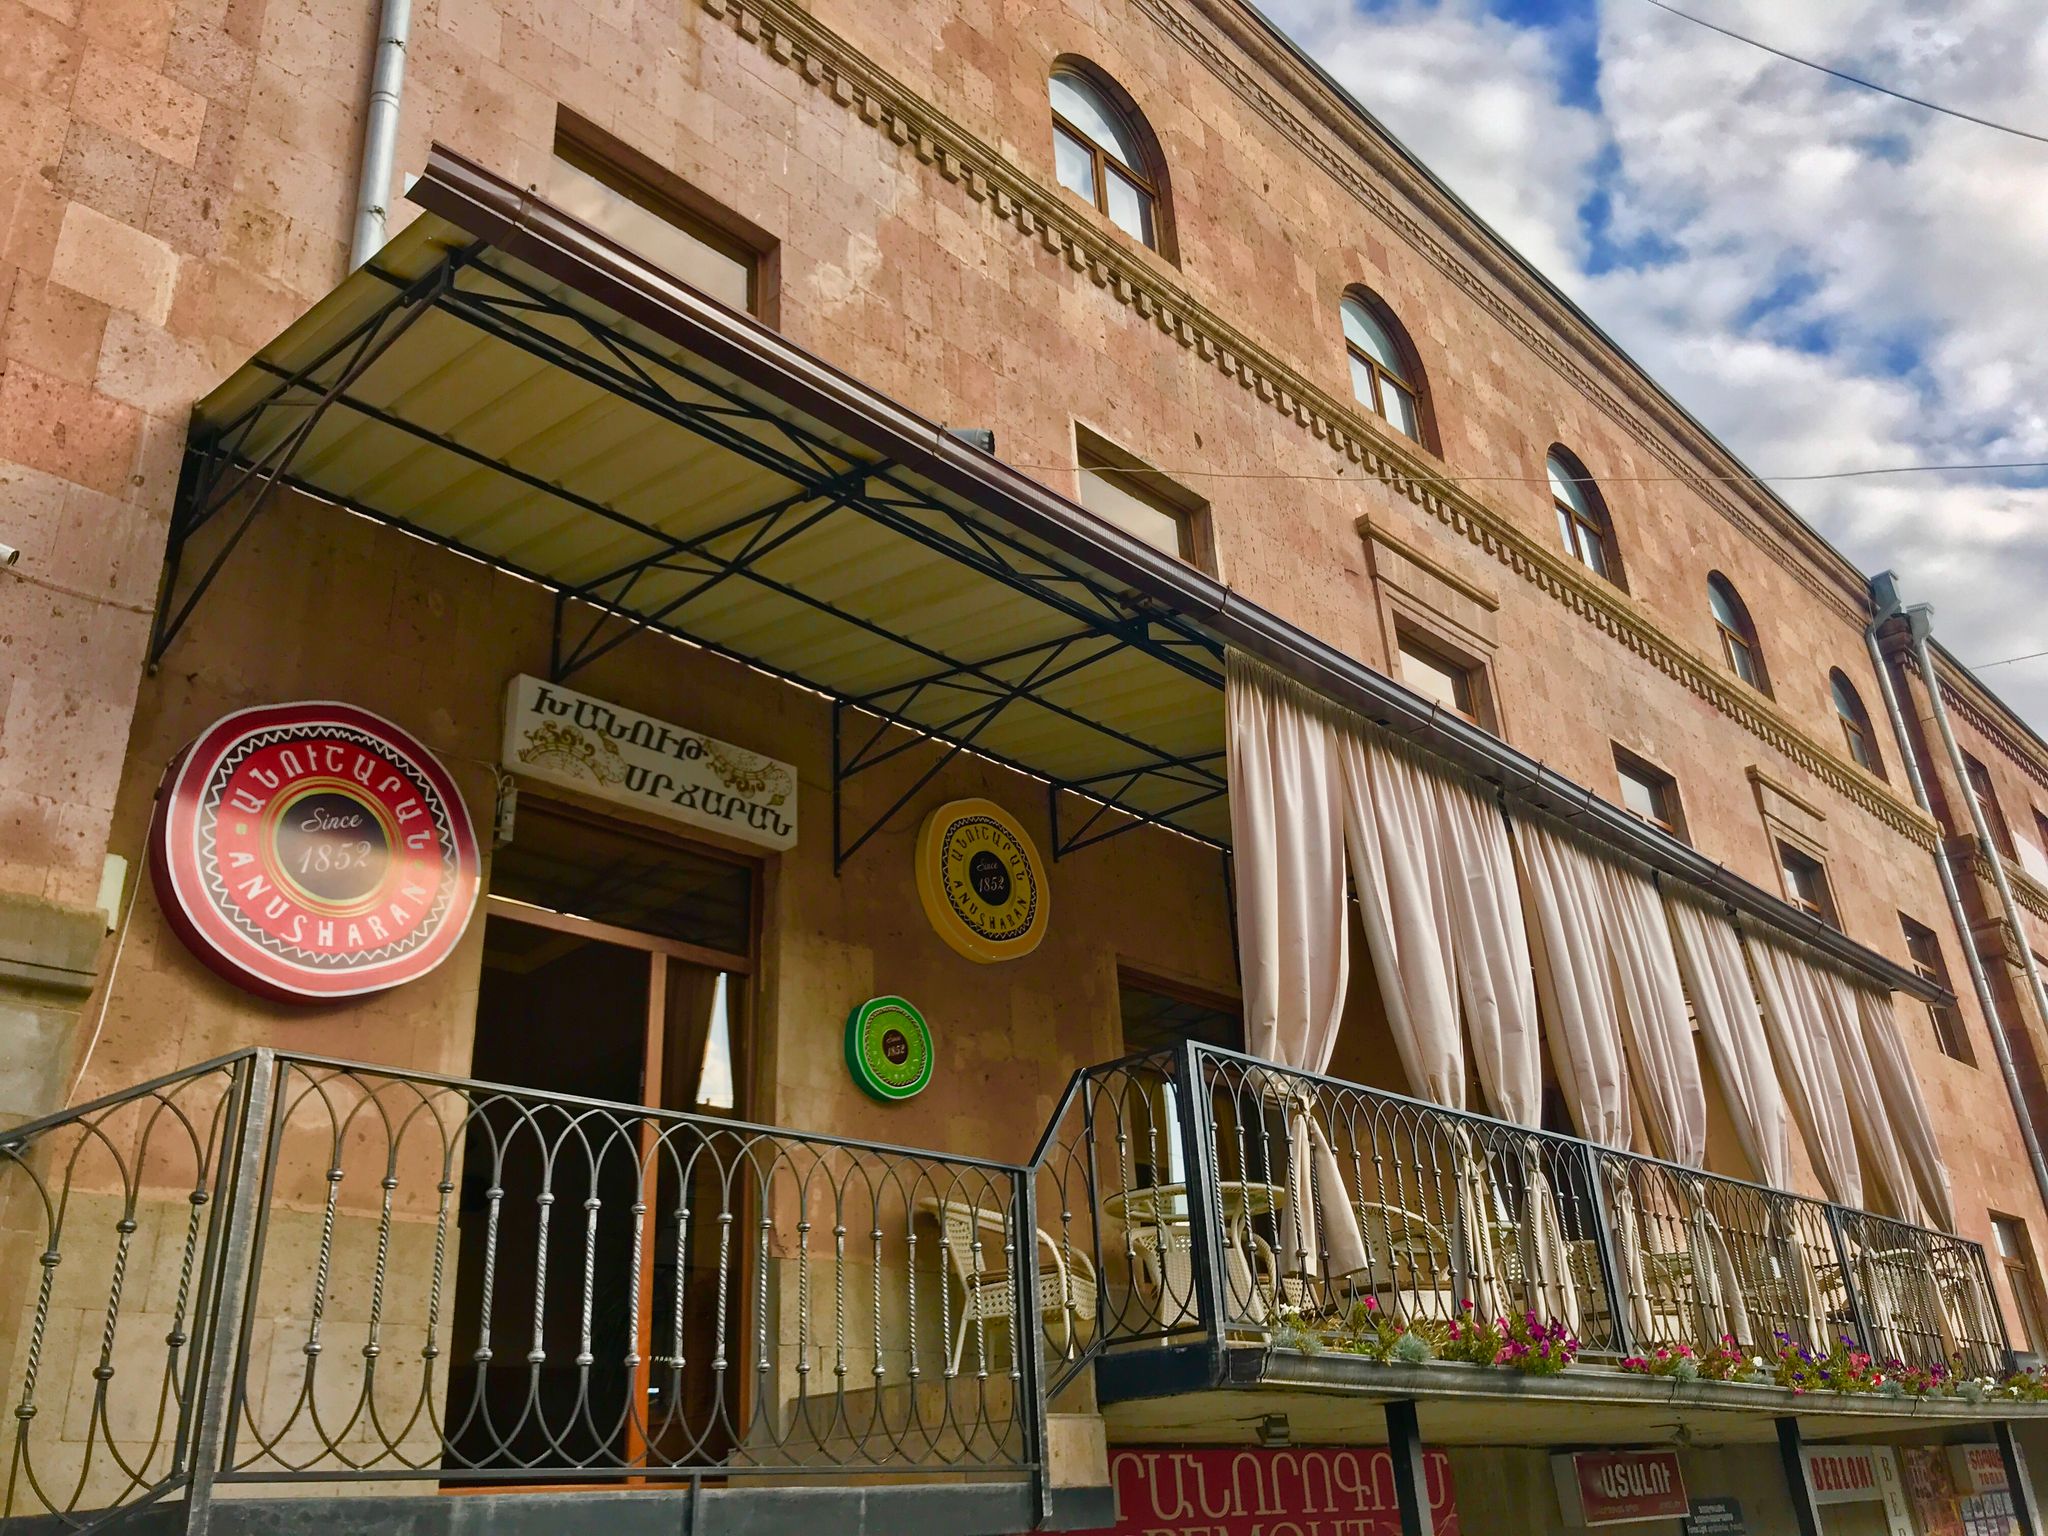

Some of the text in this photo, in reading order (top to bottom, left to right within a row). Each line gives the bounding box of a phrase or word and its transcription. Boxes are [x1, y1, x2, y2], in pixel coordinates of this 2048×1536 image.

[530, 686, 709, 761] ԽԱՆՈՒԹ
[230, 744, 432, 850] ԱՆՈՒՇԱՐԱՆ
[300, 807, 363, 832] Since
[624, 763, 793, 837] ՍՐՃԱՐԱՆ
[300, 840, 372, 874] 1852
[976, 858, 998, 872] Since
[978, 875, 1005, 893] 1852
[228, 851, 427, 948] ANUSHARAN
[953, 880, 1027, 930] ANUSHARAN
[1111, 1452, 1448, 1521] ՐԱՆՈՐՈԳՈՄ
